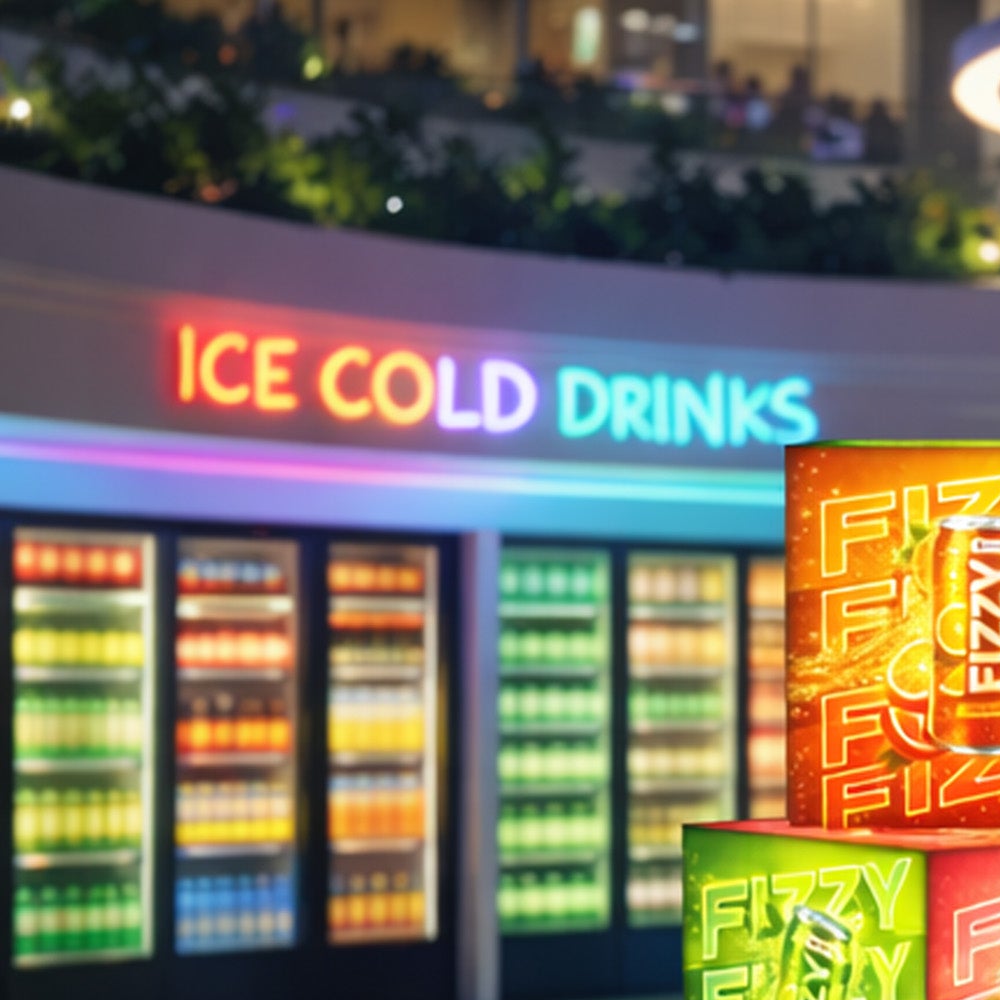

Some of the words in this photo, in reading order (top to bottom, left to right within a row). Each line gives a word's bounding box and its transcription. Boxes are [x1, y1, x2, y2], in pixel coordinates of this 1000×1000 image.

[178, 325, 298, 411] ICE
[318, 346, 538, 434] COLD
[556, 365, 819, 449] DRINKS
